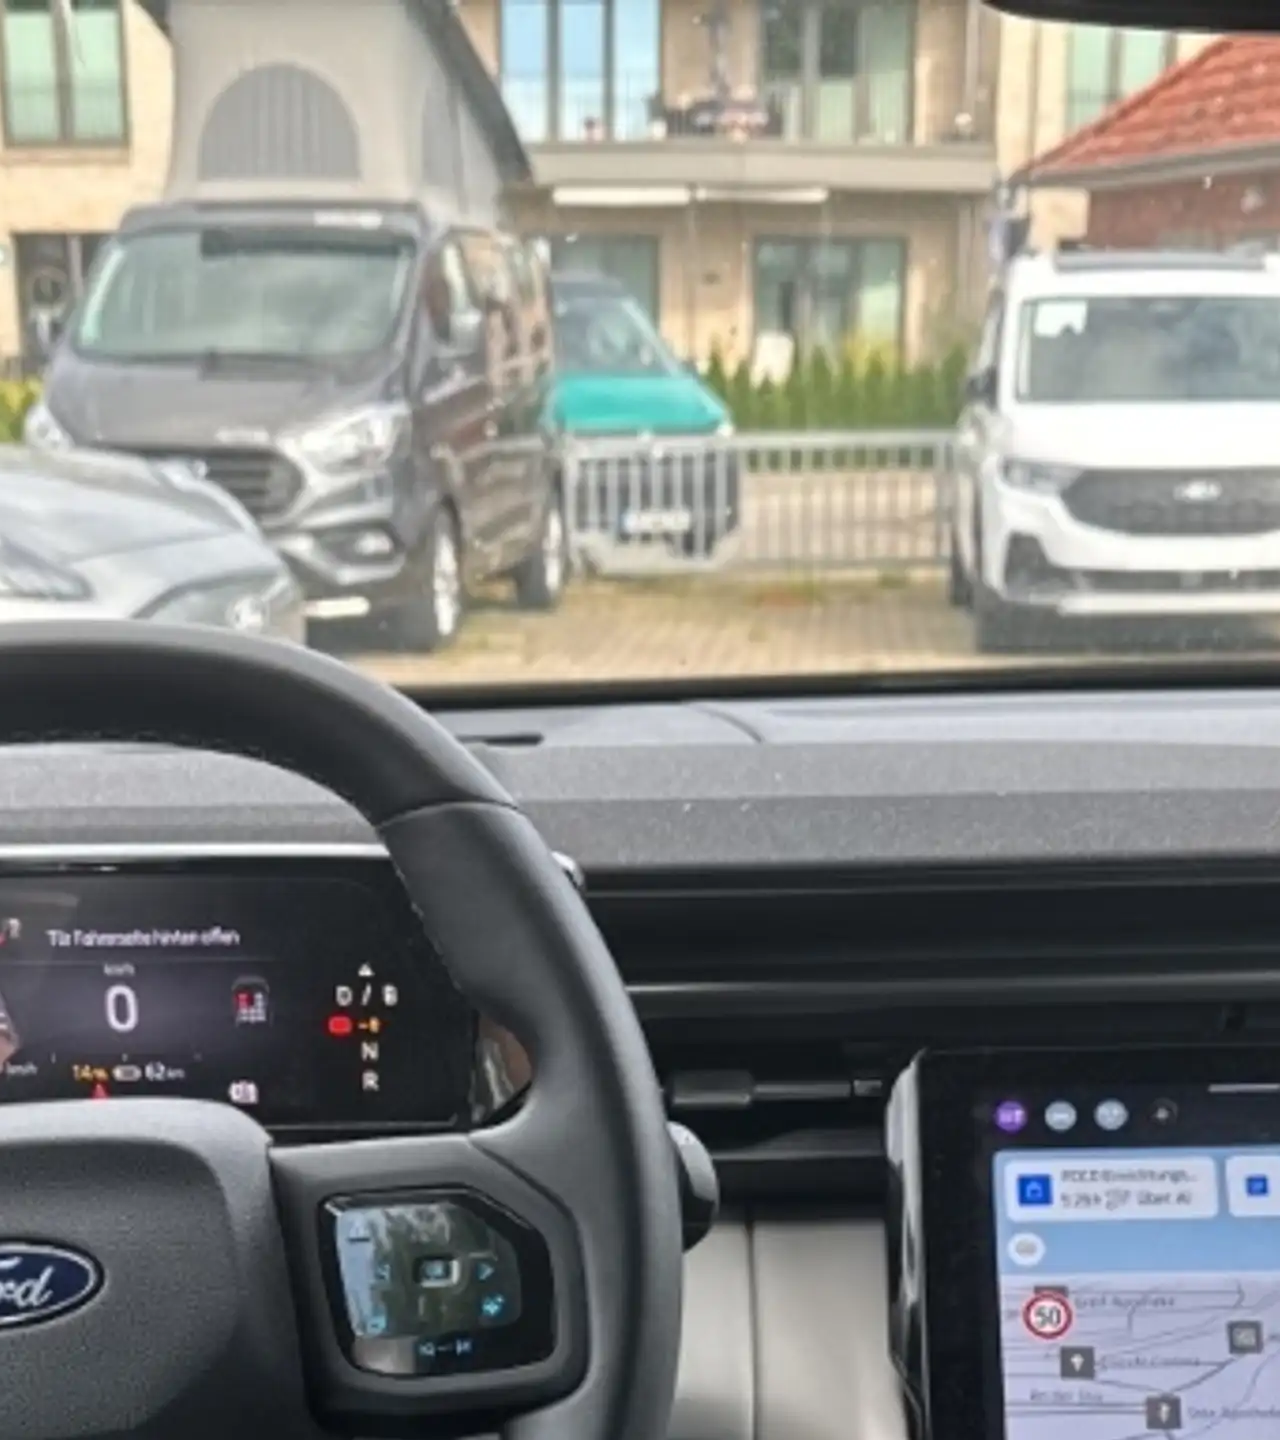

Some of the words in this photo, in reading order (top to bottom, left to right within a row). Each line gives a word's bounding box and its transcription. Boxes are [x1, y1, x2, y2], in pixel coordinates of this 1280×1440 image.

[105, 983, 140, 1033] 0
[361, 1041, 379, 1061] N
[362, 1069, 380, 1091] R
[1033, 1305, 1062, 1327] 50
